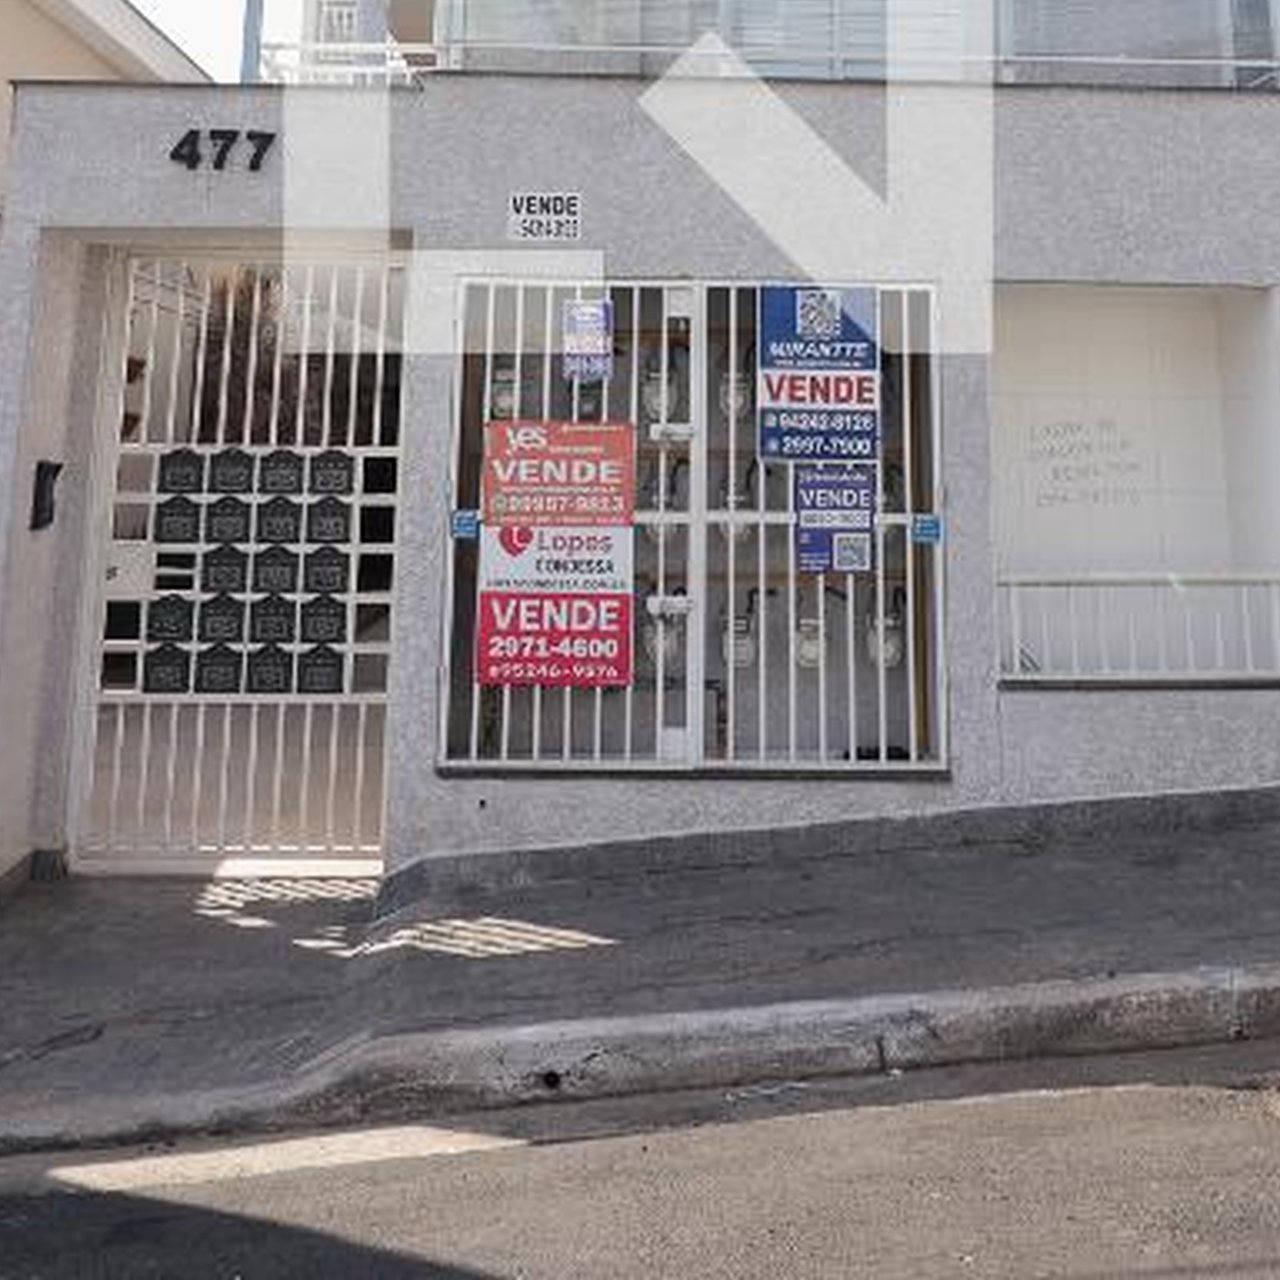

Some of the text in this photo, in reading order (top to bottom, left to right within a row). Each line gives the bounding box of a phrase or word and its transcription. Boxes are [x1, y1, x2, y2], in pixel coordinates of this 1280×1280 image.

[170, 129, 277, 170] 477
[512, 195, 579, 216] VENDE
[764, 374, 875, 405] VENDE
[491, 459, 623, 484] VENDE
[800, 489, 871, 507] VENDE
[491, 598, 620, 631] VENDE
[489, 636, 617, 658] 2971-4600
